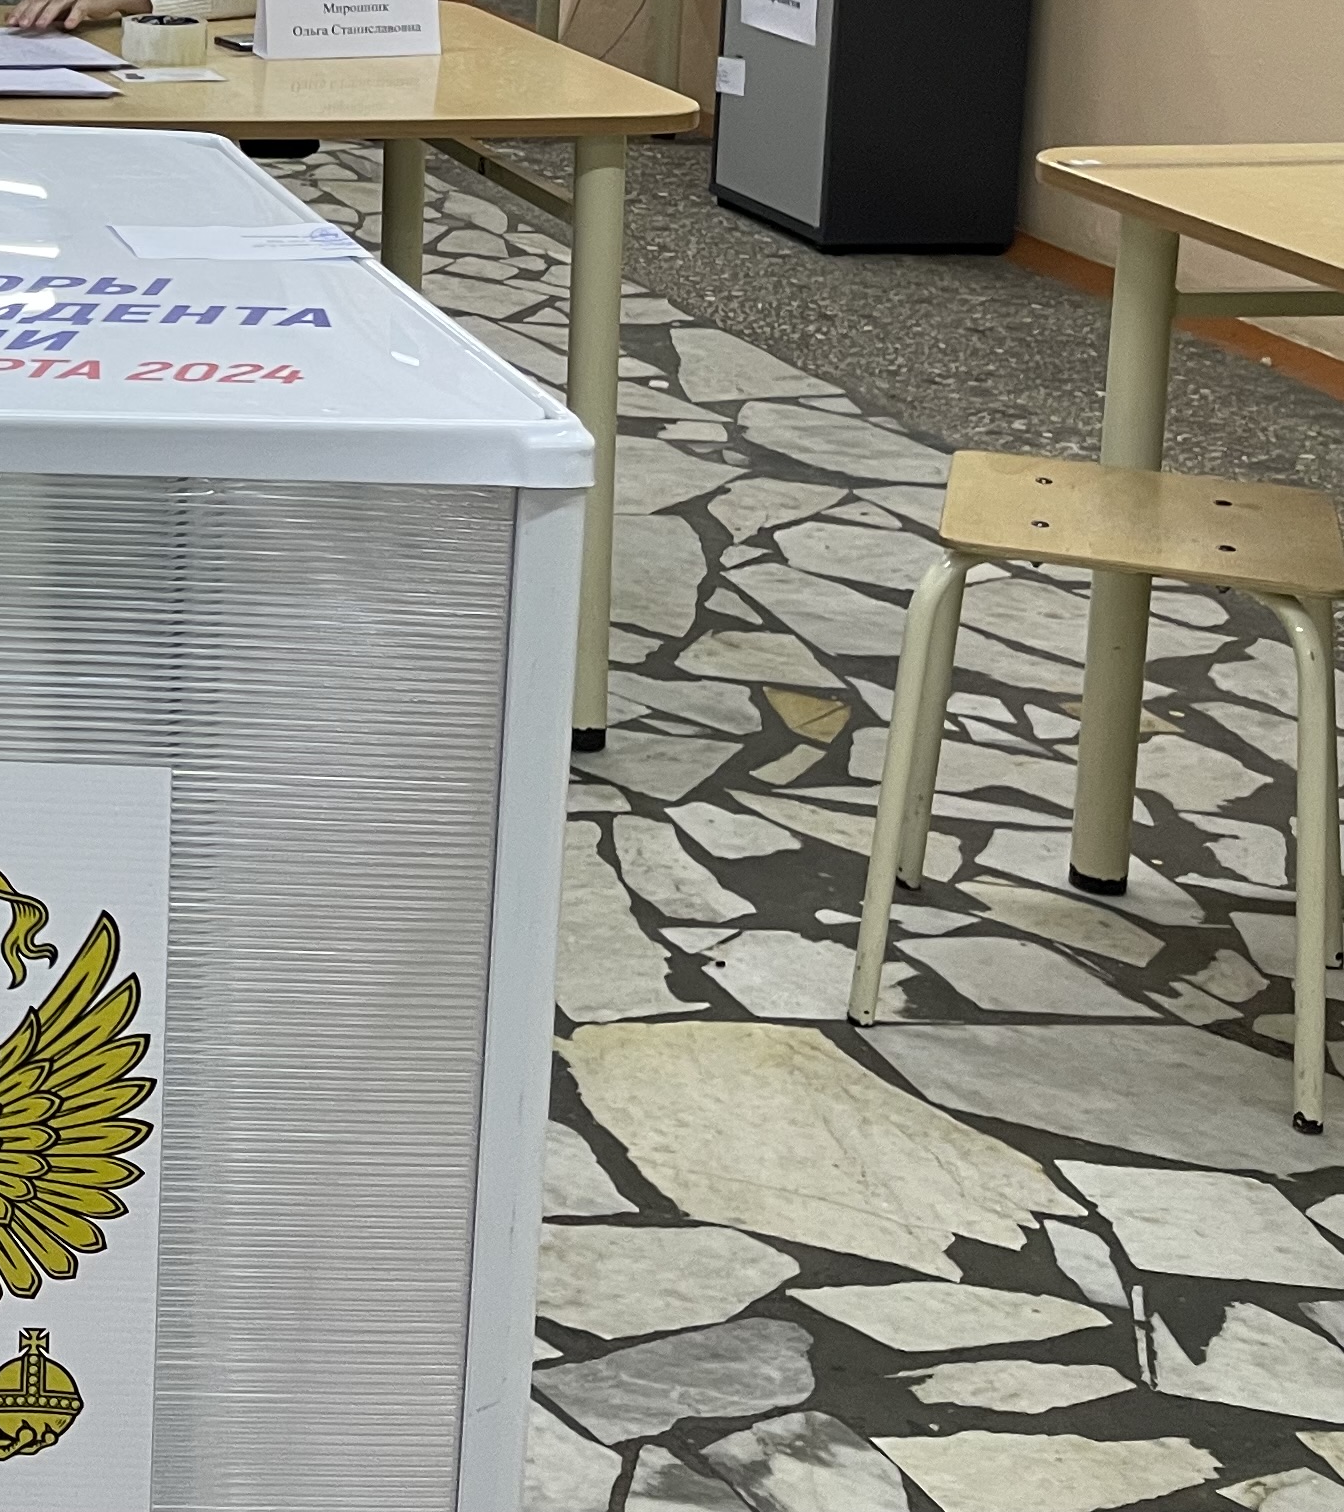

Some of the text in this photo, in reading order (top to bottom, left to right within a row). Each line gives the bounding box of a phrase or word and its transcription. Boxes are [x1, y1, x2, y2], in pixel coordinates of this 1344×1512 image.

[323, 2, 389, 15] Мирошник
[293, 23, 422, 37] Ольга Станиславовна
[123, 360, 306, 385] 2024
